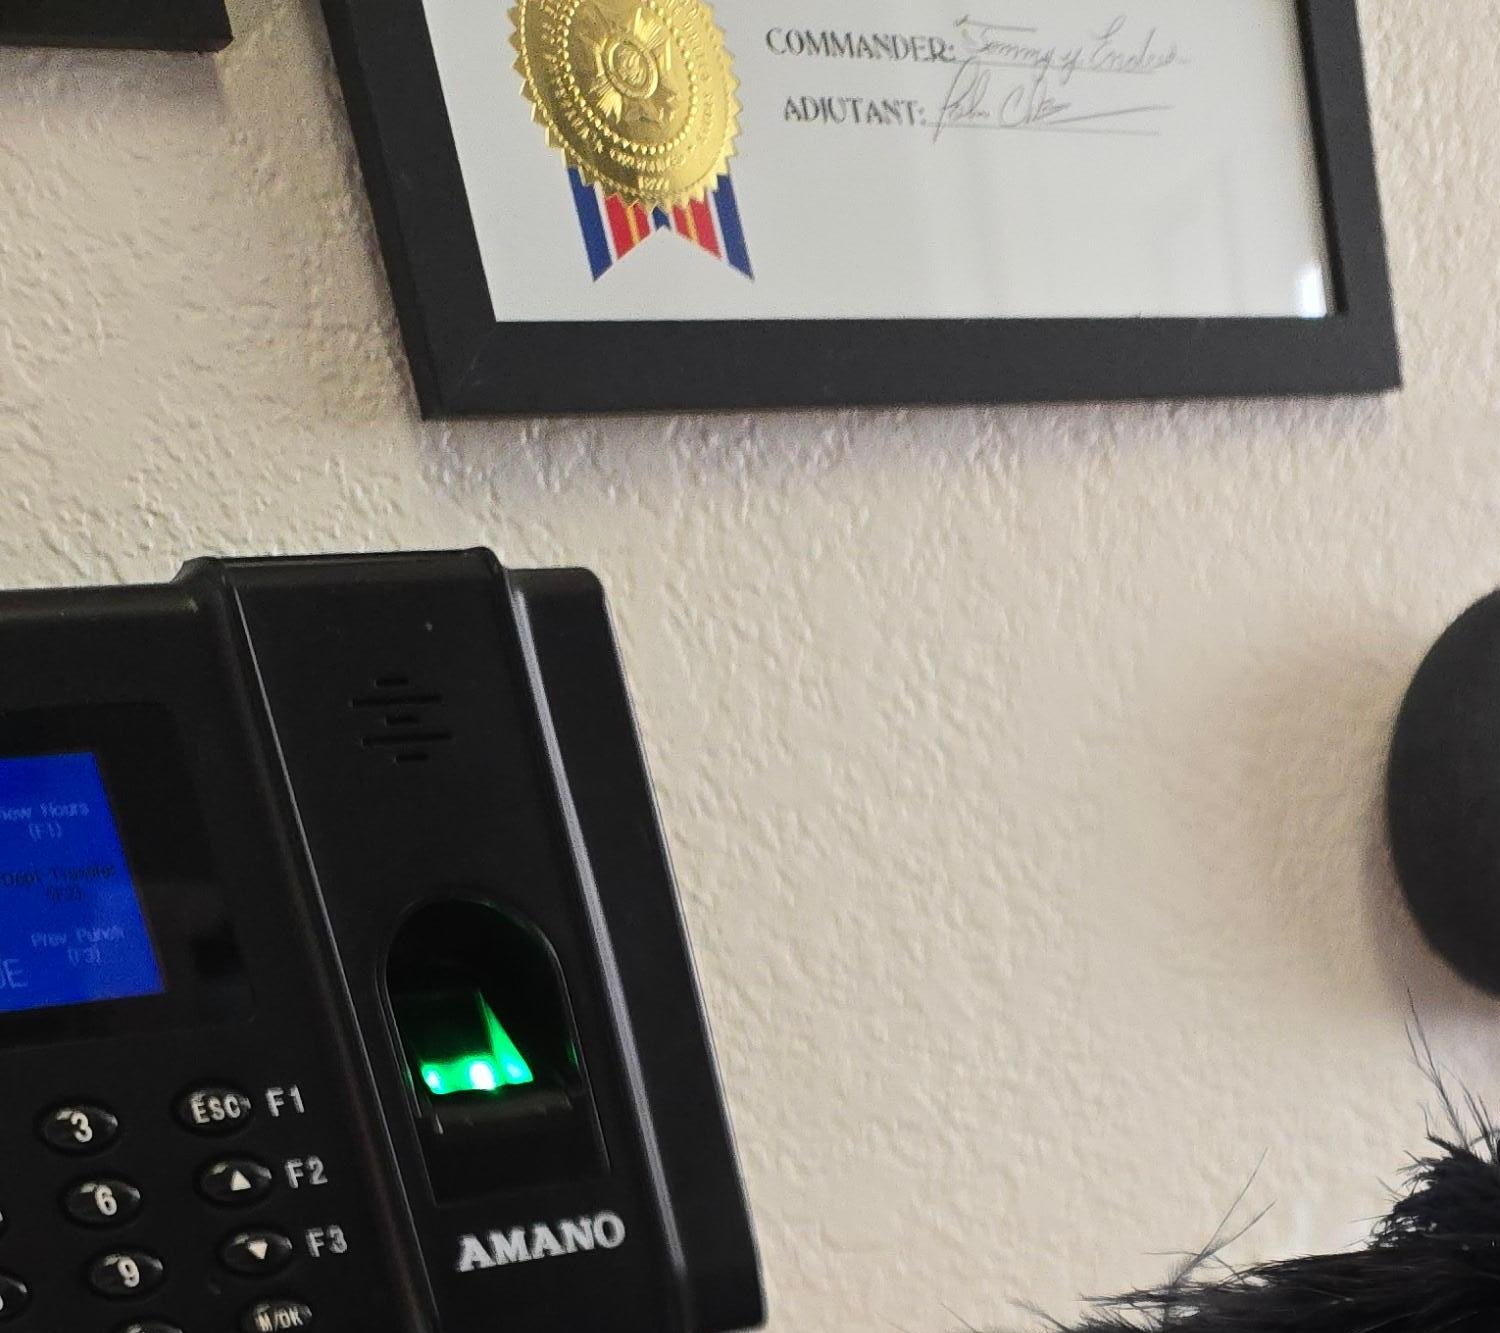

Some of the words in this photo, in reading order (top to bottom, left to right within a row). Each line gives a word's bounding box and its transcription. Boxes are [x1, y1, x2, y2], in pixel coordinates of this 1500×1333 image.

[765, 27, 955, 63] COMMANDER:
[266, 1084, 304, 1117] F1
[71, 1111, 92, 1142] 3
[285, 1156, 327, 1189] F2
[95, 1184, 117, 1215] 6
[306, 1225, 347, 1257] F3
[456, 1210, 626, 1272] AMANO
[118, 1255, 140, 1288] 9
